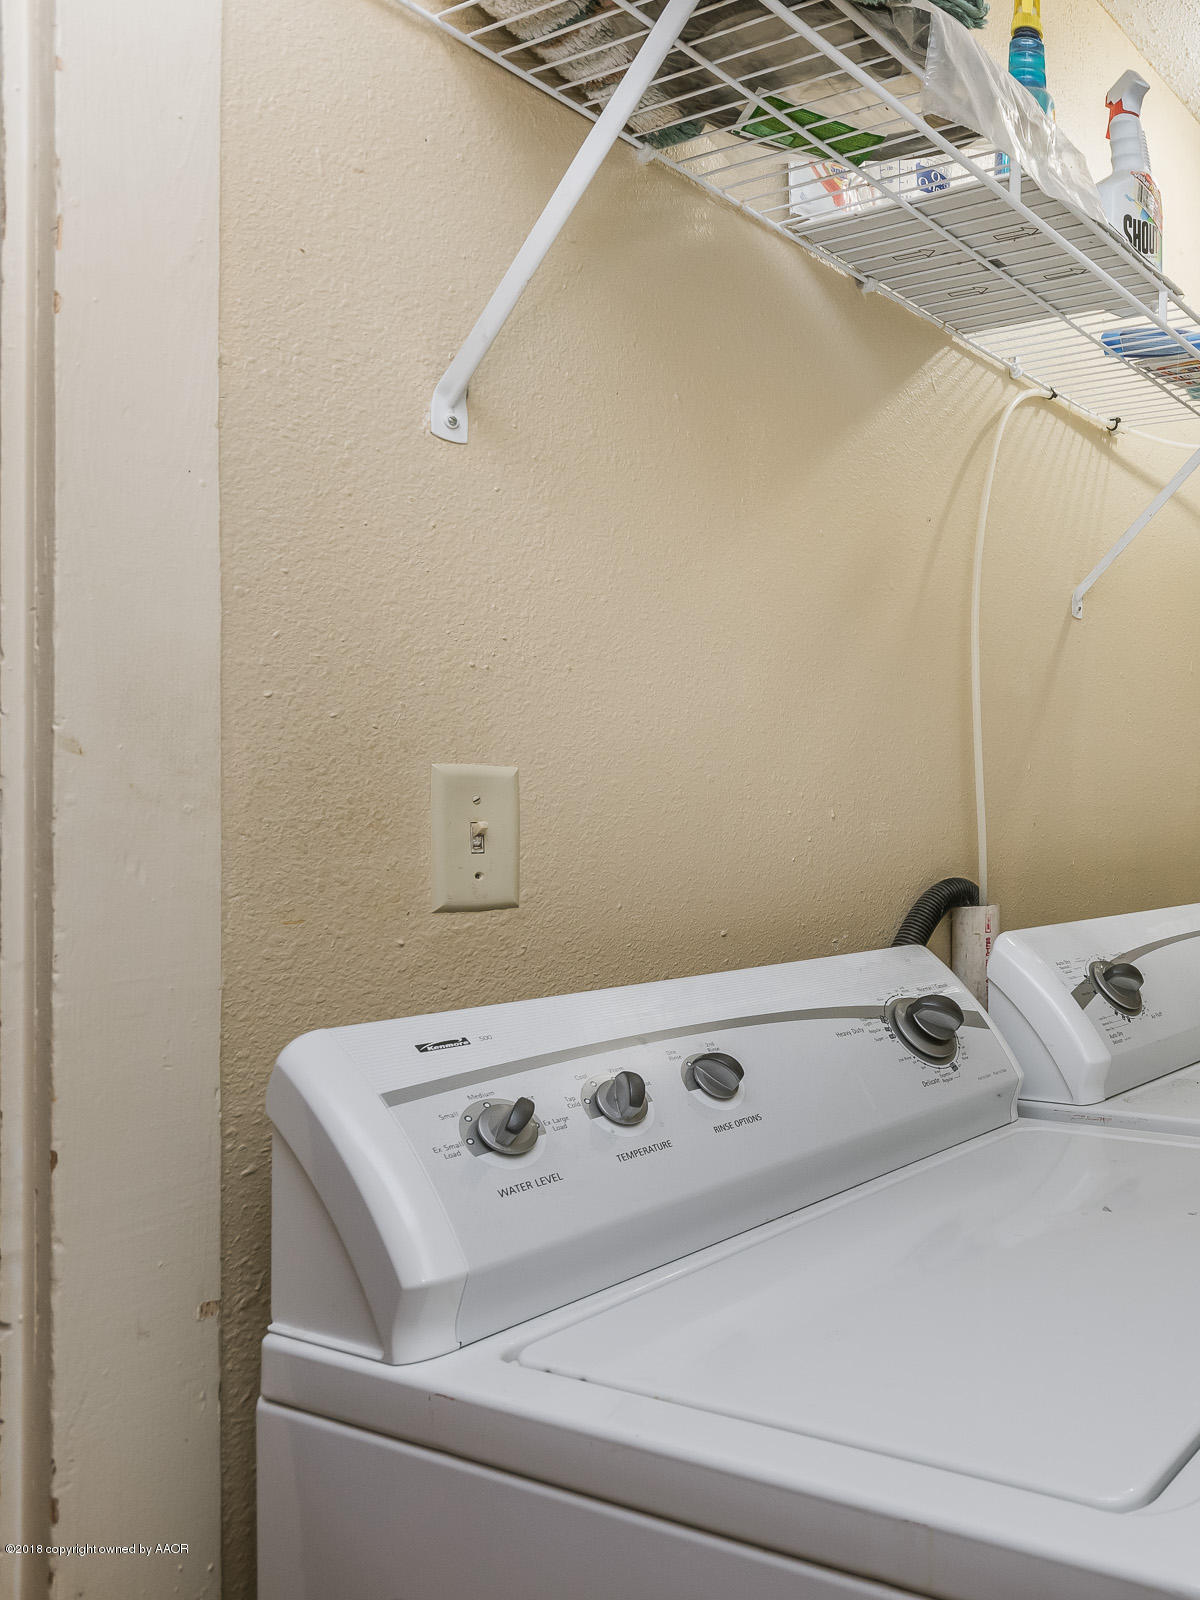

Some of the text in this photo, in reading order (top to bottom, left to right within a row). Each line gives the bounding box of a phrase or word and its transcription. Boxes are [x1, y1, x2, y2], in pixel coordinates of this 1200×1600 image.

[426, 1040, 470, 1051] Kenmore
[438, 1111, 459, 1121] Small
[552, 1115, 570, 1125] Large
[552, 1123, 568, 1132] Load
[713, 1113, 763, 1134] RINSE OPTIONS
[432, 1141, 464, 1154] Ex Small
[616, 1140, 673, 1163] TEMPERATURE
[443, 1151, 462, 1160] Load
[497, 1172, 564, 1198] WATER LEVEL
